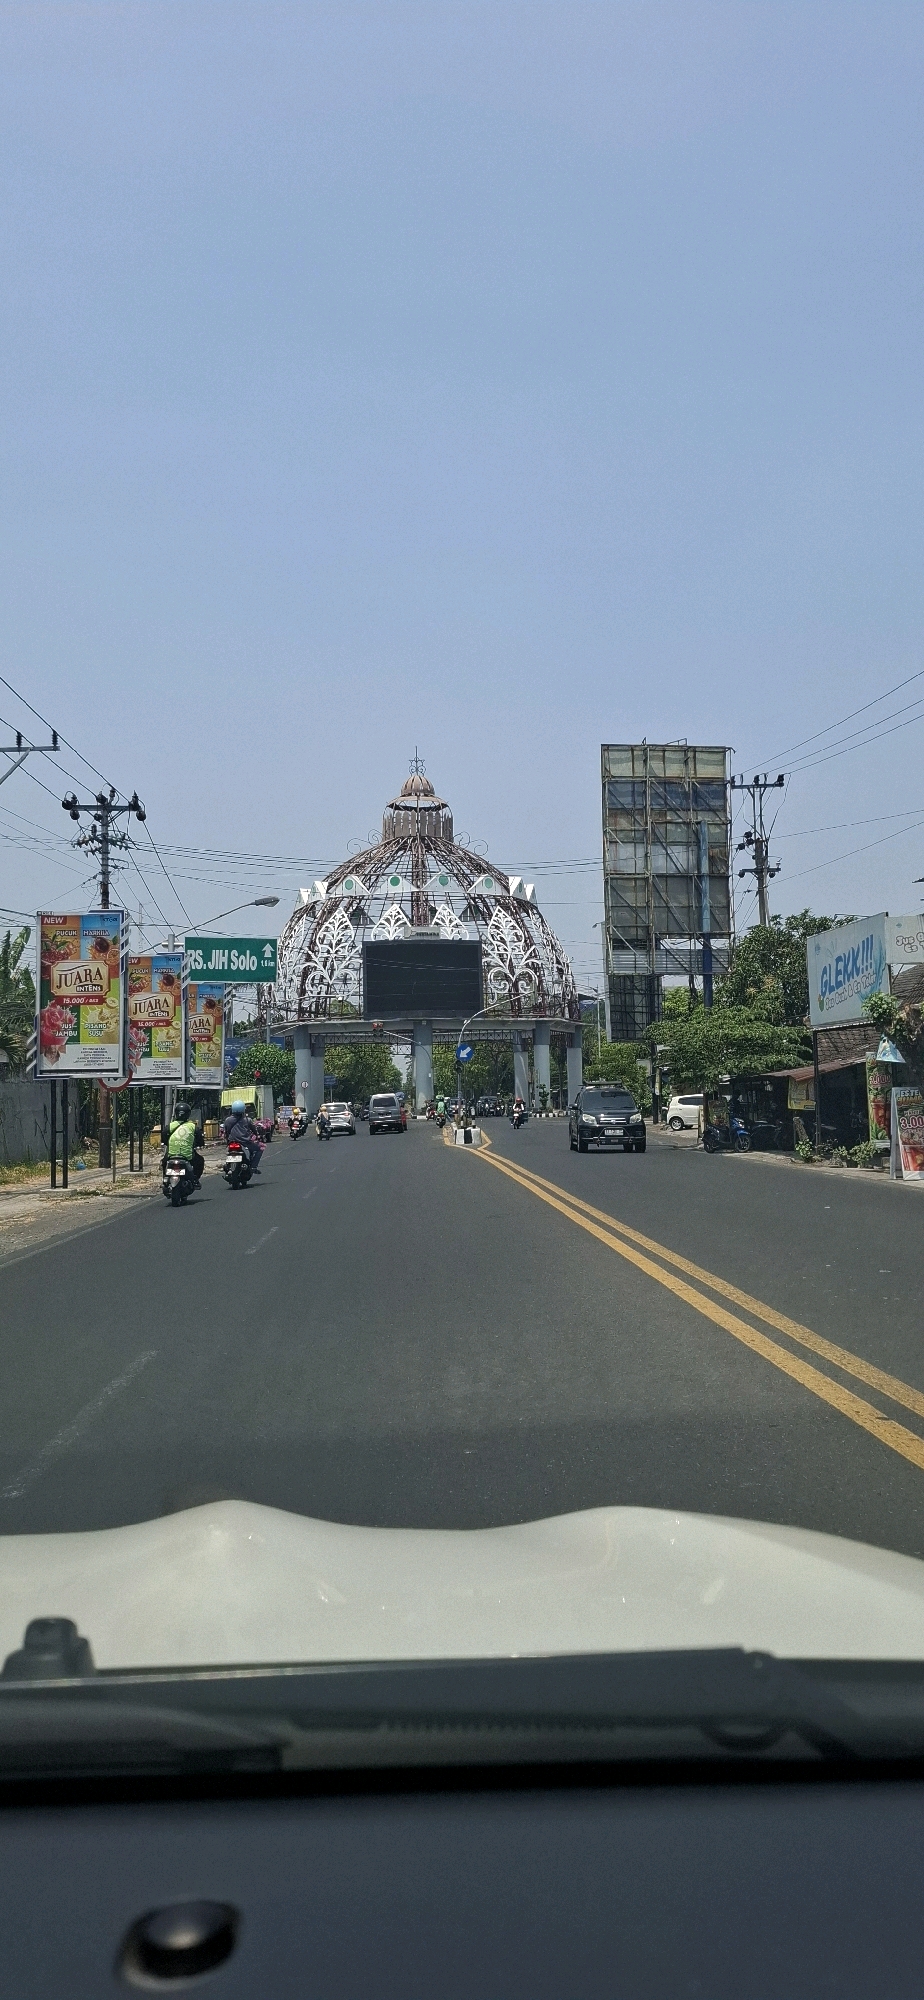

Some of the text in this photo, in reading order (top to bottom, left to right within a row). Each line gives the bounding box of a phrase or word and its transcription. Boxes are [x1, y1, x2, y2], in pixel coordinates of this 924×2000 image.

[187, 949, 258, 971] RS. JIH Solo
[820, 934, 874, 998] GLEKK!!!
[56, 967, 104, 989] JUARA
[133, 997, 170, 1016] JUARA
[900, 1115, 924, 1130] 3.00
